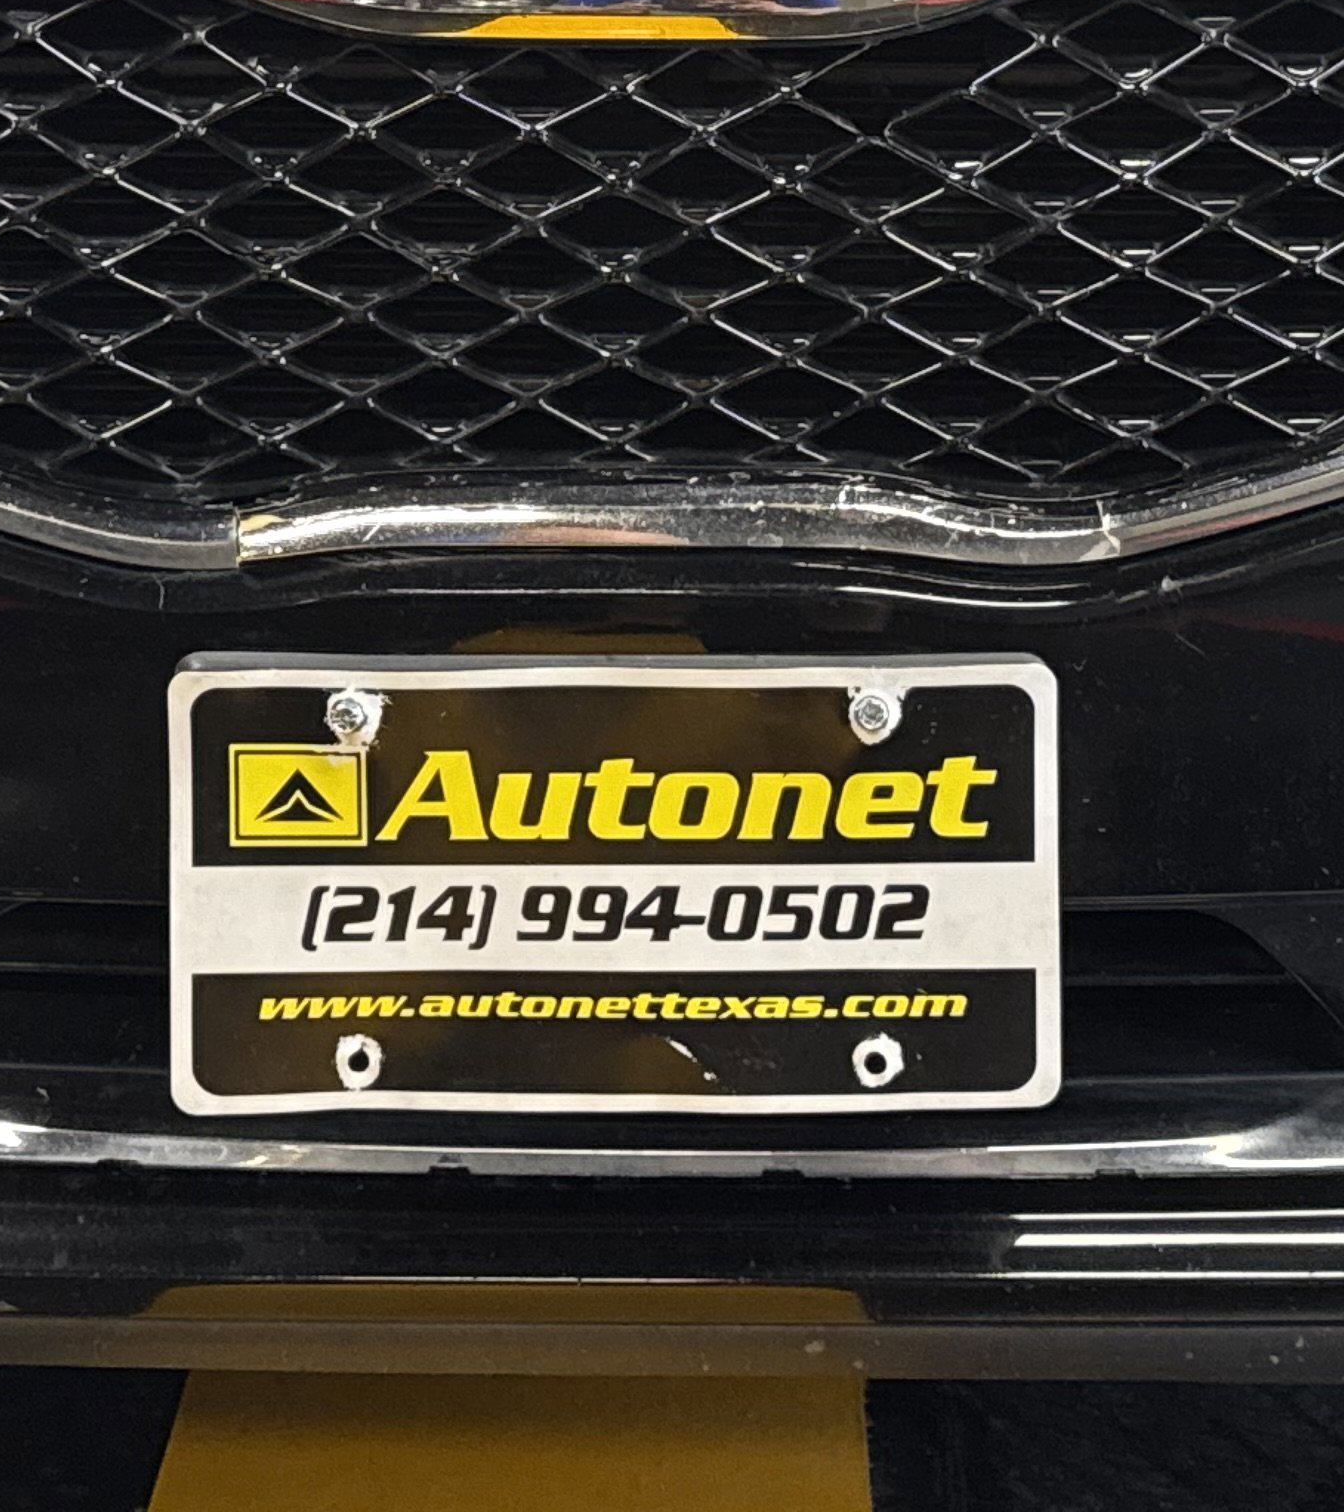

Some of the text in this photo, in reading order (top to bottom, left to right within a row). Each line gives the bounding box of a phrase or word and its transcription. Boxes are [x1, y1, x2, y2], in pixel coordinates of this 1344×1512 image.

[374, 749, 998, 842] Autonet
[301, 884, 930, 951] (214) 994-0502
[257, 989, 968, 1021] www.autonettexas.com
